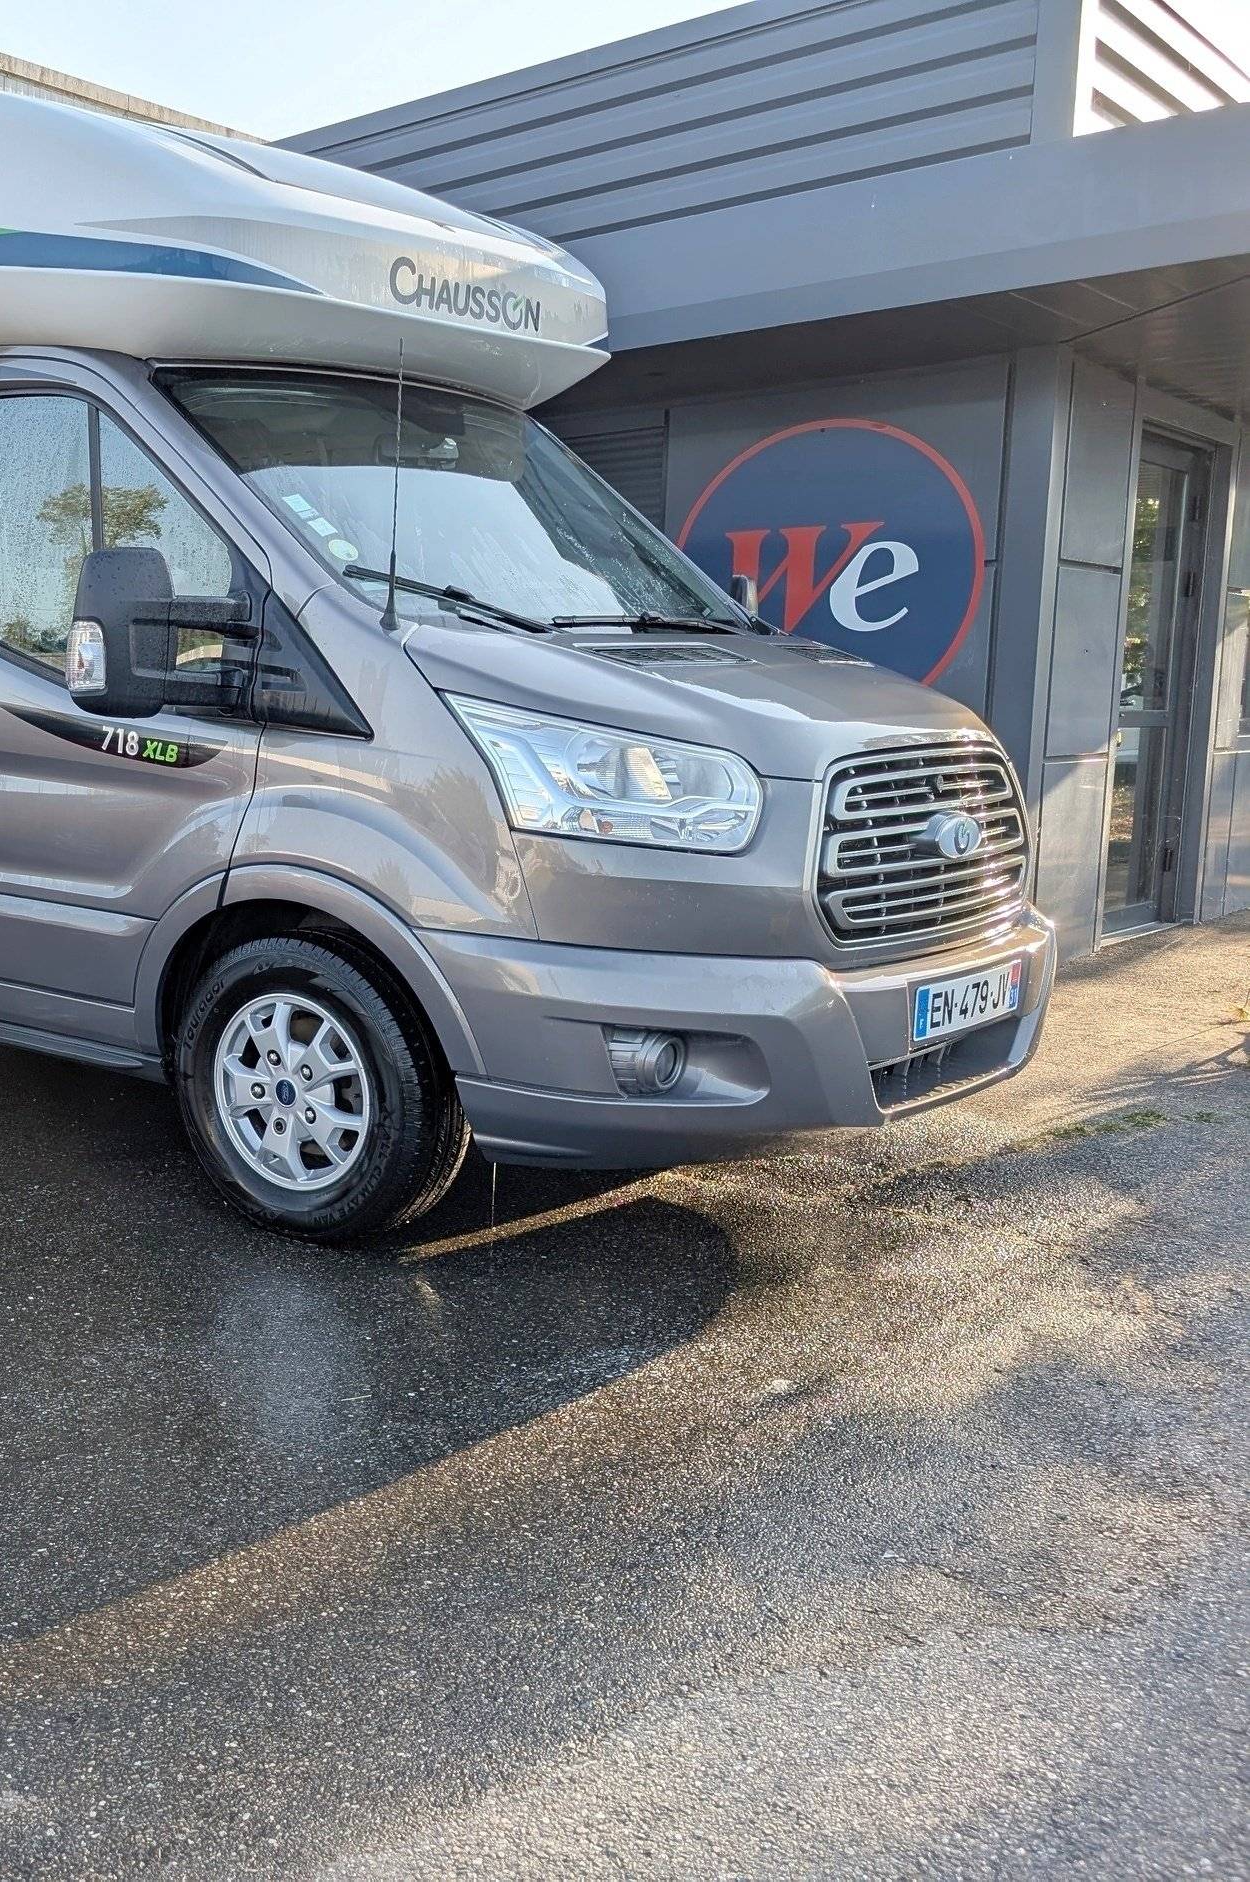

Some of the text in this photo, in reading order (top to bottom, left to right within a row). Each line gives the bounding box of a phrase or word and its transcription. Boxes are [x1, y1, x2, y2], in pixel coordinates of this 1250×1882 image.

[390, 256, 541, 332] CHAUSSON
[101, 725, 179, 763] 718 XLB
